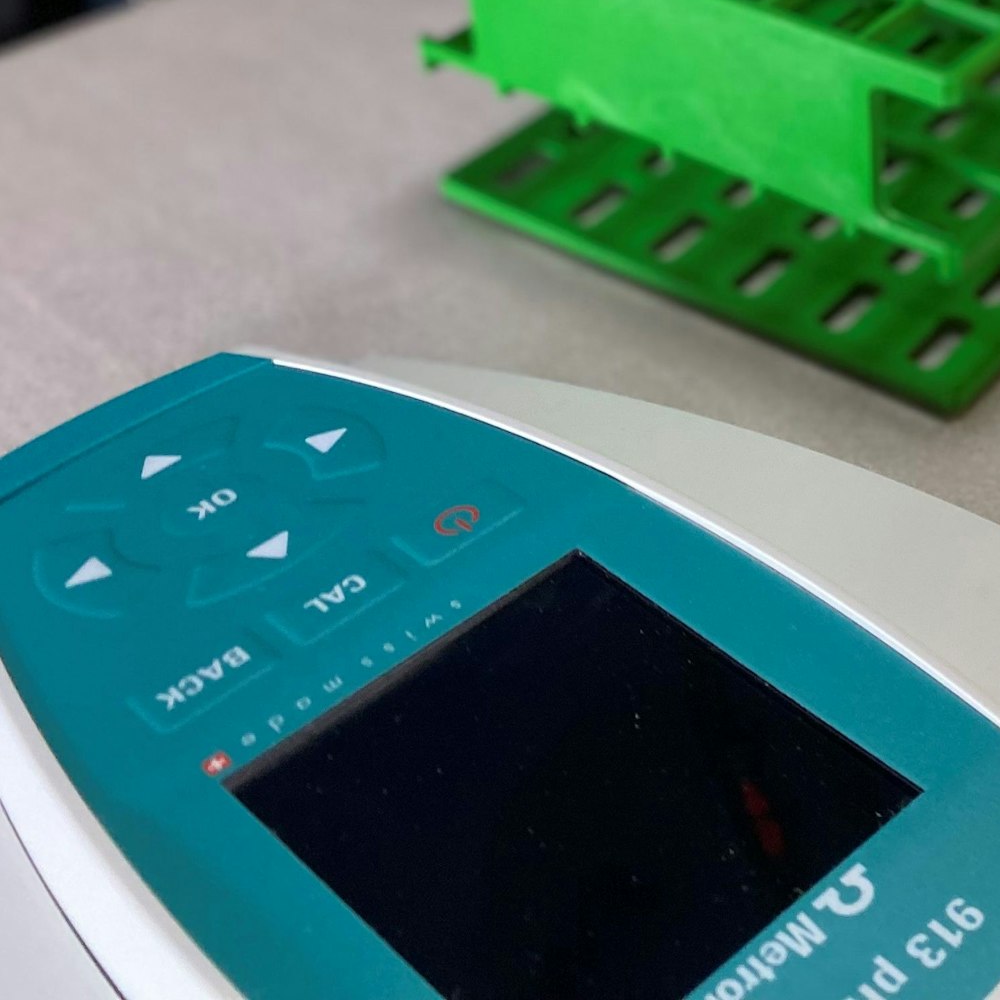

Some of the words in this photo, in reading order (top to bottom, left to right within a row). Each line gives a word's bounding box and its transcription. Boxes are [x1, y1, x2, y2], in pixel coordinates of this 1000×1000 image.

[186, 487, 238, 521] OK
[303, 573, 368, 614] CAL
[360, 599, 463, 668] swiss
[155, 644, 252, 711] BACK
[240, 676, 344, 748] made
[702, 910, 829, 1000] Metro
[904, 897, 985, 970] 913
